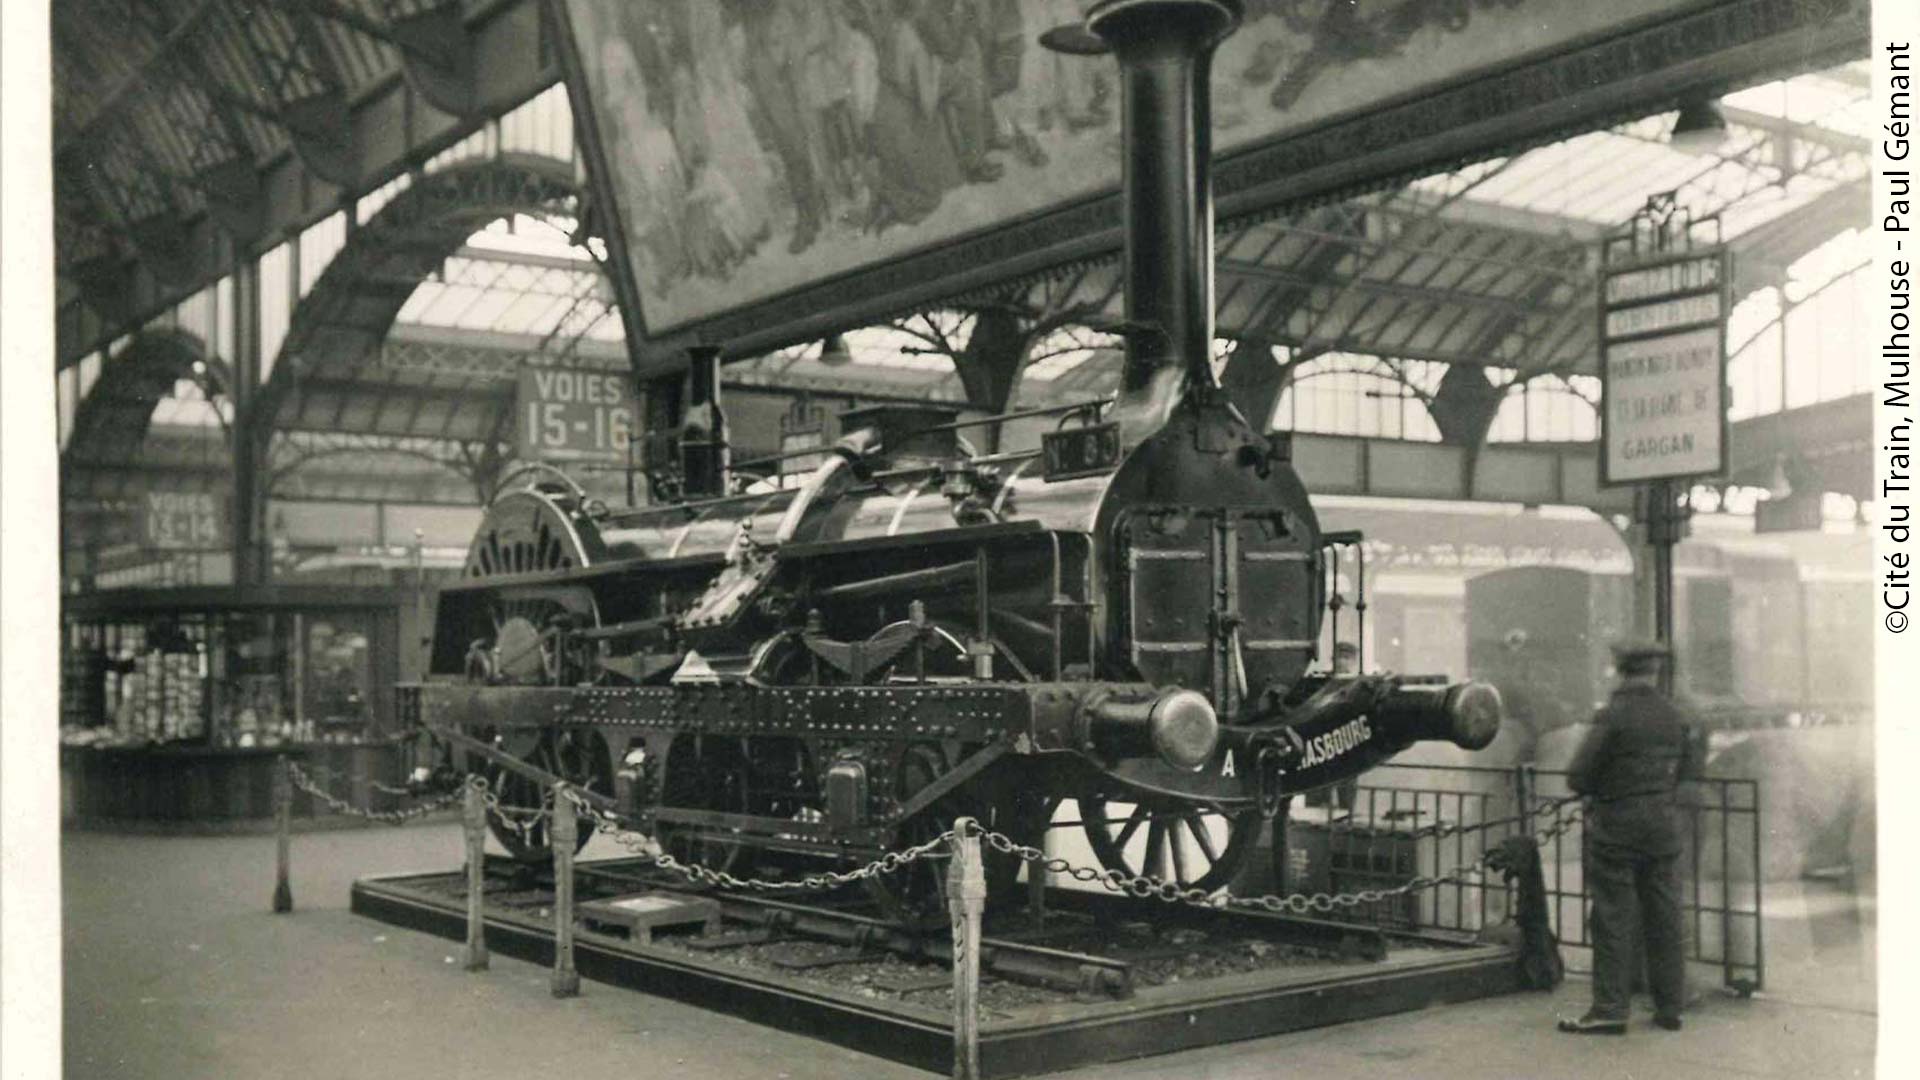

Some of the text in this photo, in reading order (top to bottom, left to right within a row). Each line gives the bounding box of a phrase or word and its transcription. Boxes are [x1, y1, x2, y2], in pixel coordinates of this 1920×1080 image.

[534, 370, 622, 405] VOIES
[528, 401, 631, 450] 15-16
[1622, 432, 1695, 461] GARGAN
[147, 491, 215, 513] VOIES
[1221, 713, 1372, 777] A ASBOURG
